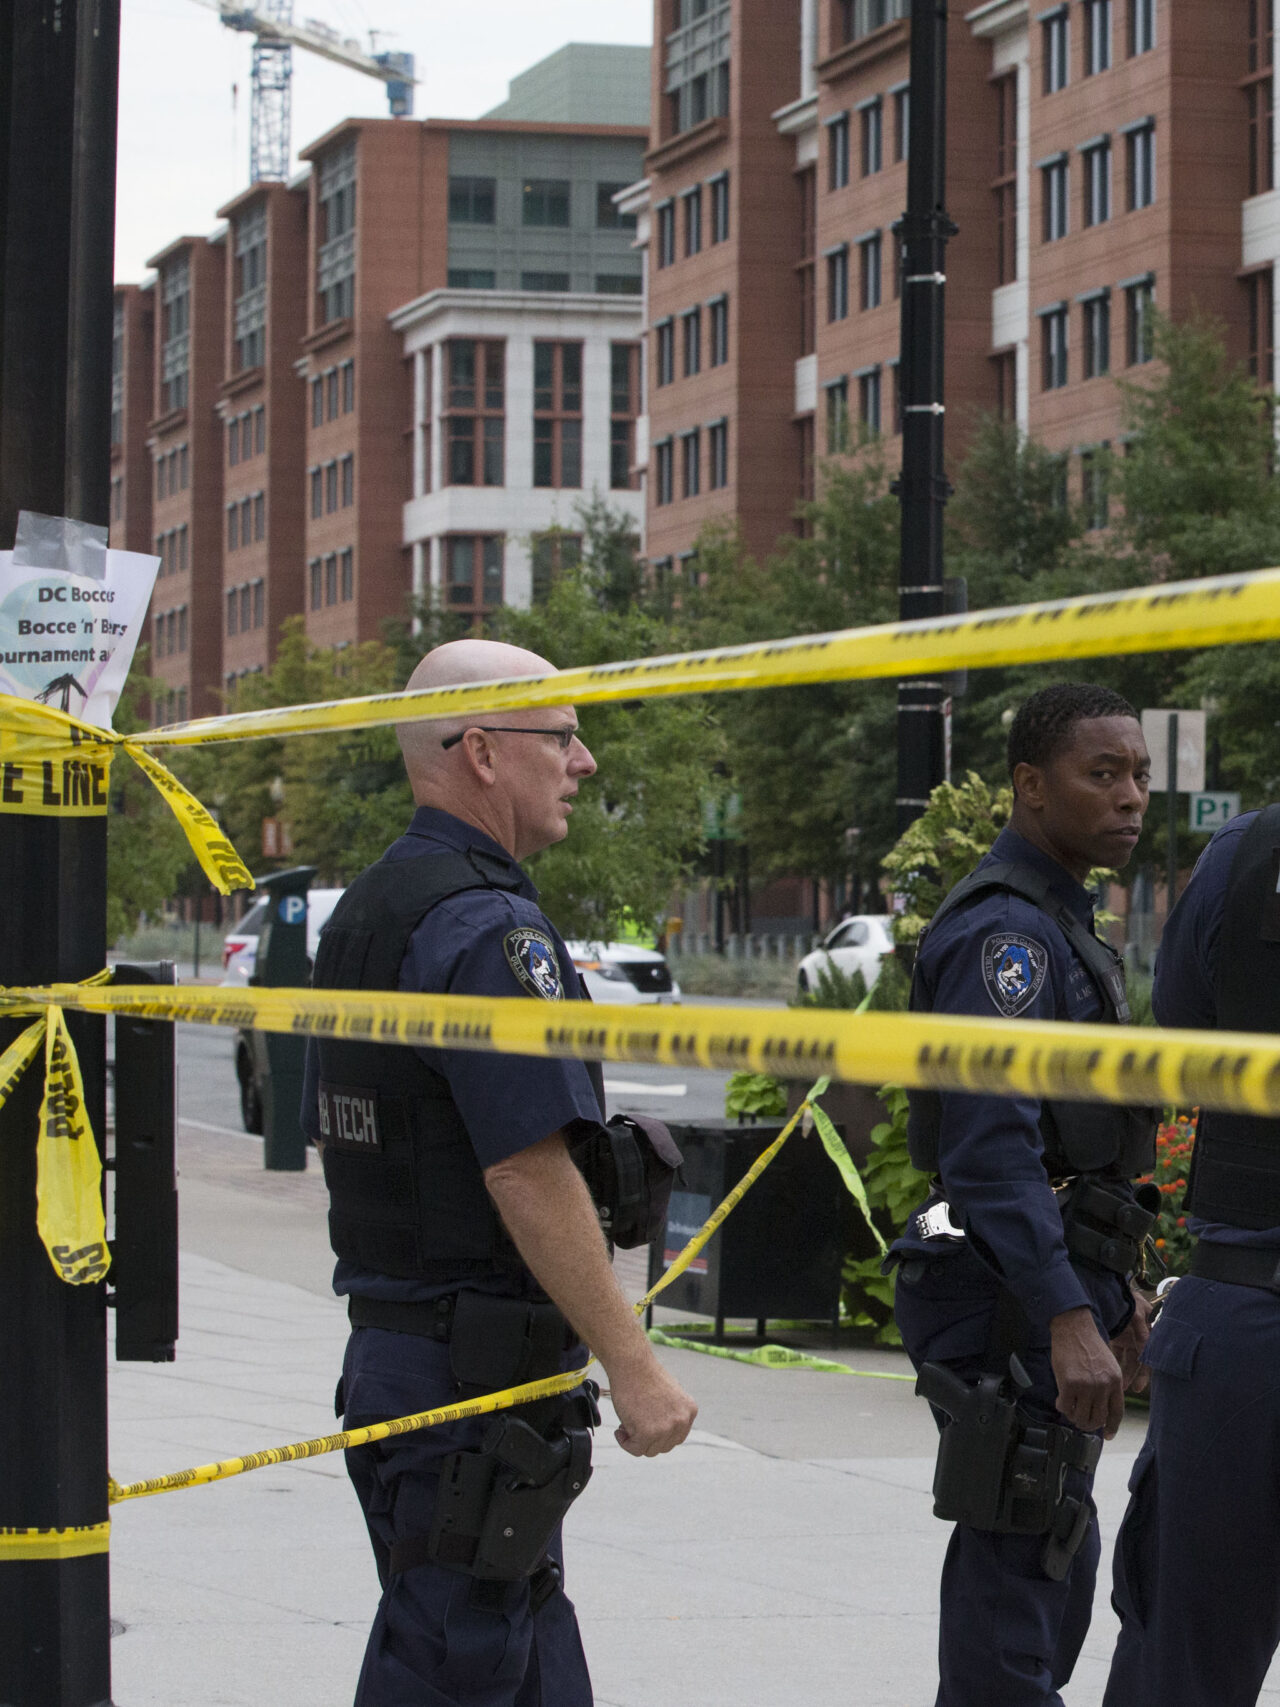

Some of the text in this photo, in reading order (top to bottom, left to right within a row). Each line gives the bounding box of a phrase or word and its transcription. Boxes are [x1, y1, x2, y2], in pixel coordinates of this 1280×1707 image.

[38, 586, 67, 603] DC
[18, 619, 76, 635] Bocce
[42, 760, 107, 806] LINE
[1197, 797, 1216, 825] P
[286, 896, 303, 923] P
[333, 1094, 378, 1145] TECH
